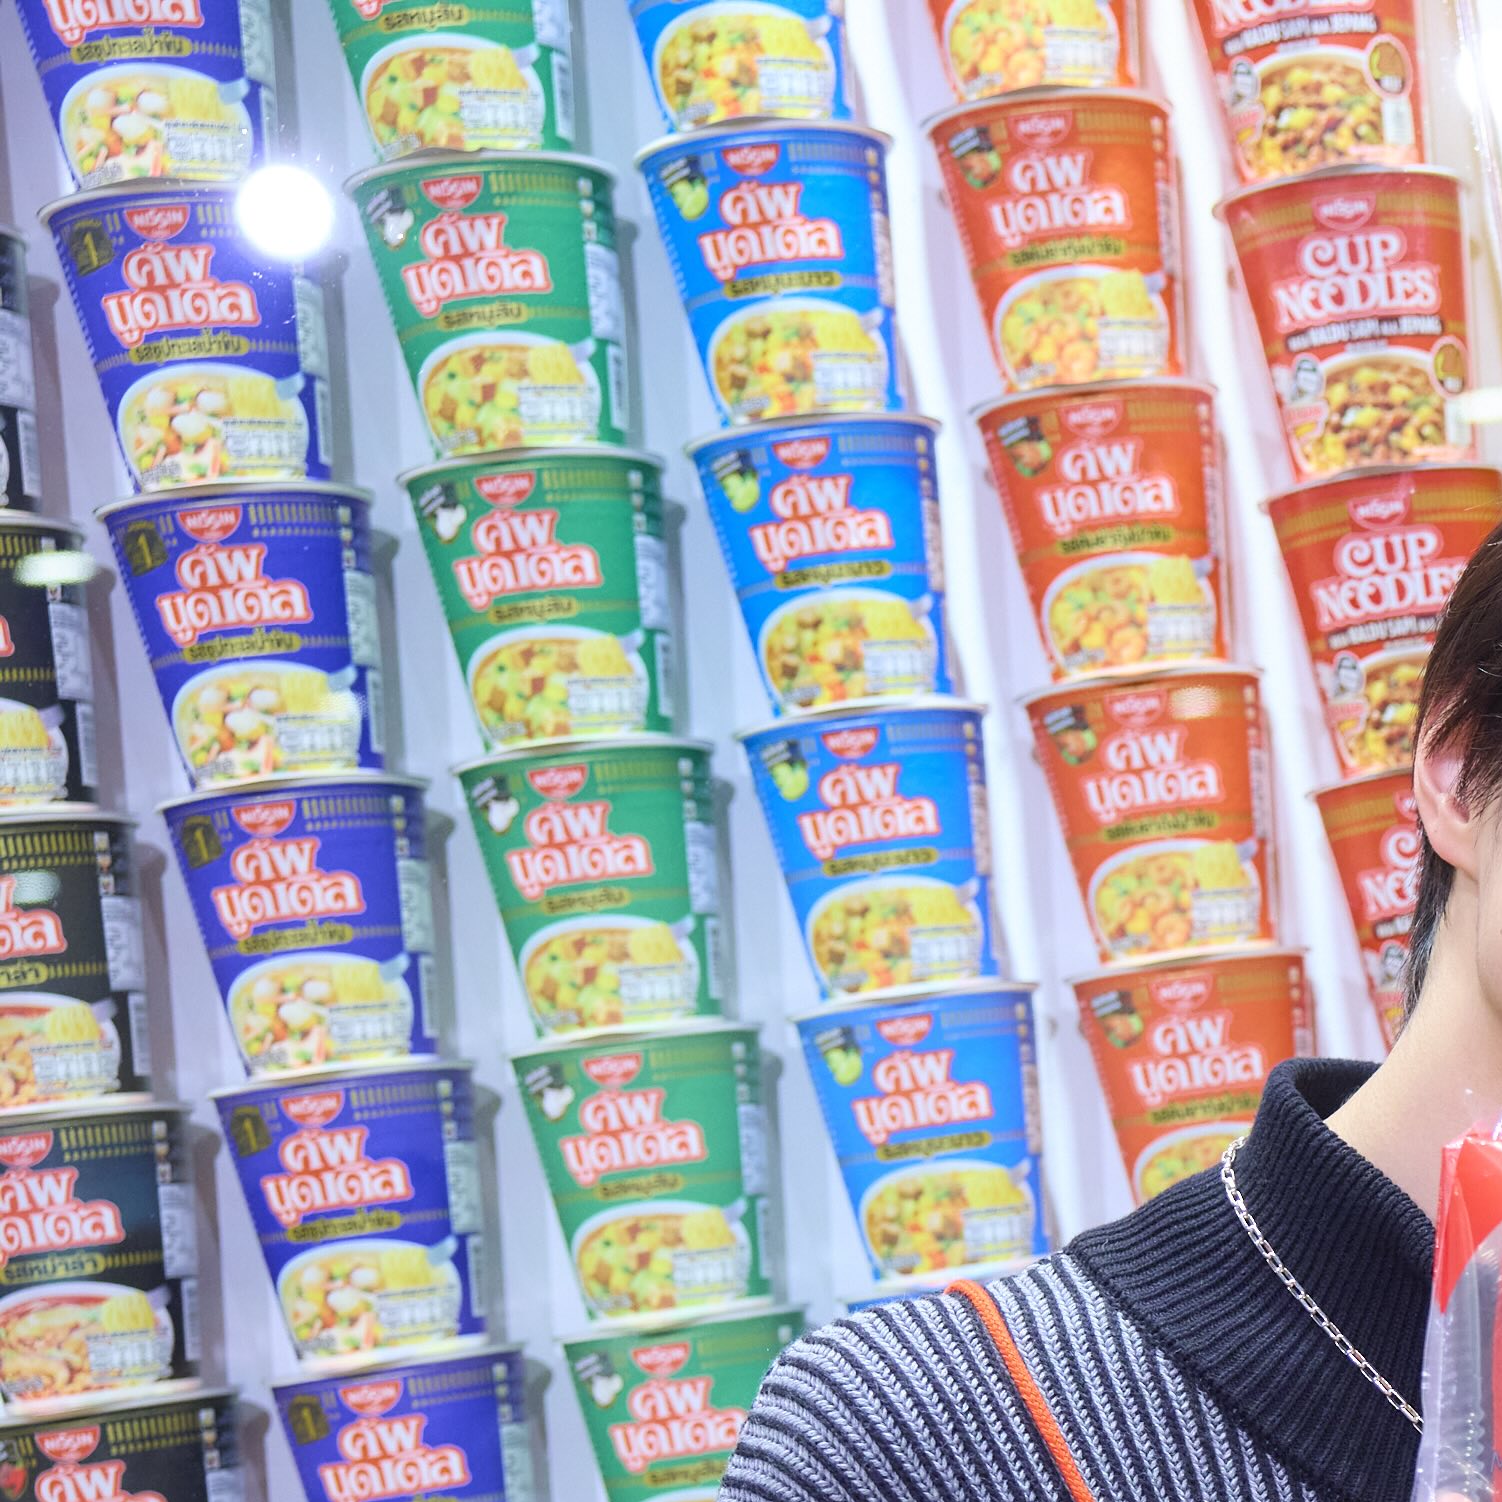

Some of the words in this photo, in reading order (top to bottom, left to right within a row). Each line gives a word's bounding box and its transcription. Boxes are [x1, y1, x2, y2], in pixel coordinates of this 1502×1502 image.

[1299, 228, 1405, 278] CUP
[1272, 263, 1440, 331] NOODLES
[1337, 526, 1442, 578] CUP
[1313, 560, 1467, 629] NOODLE
